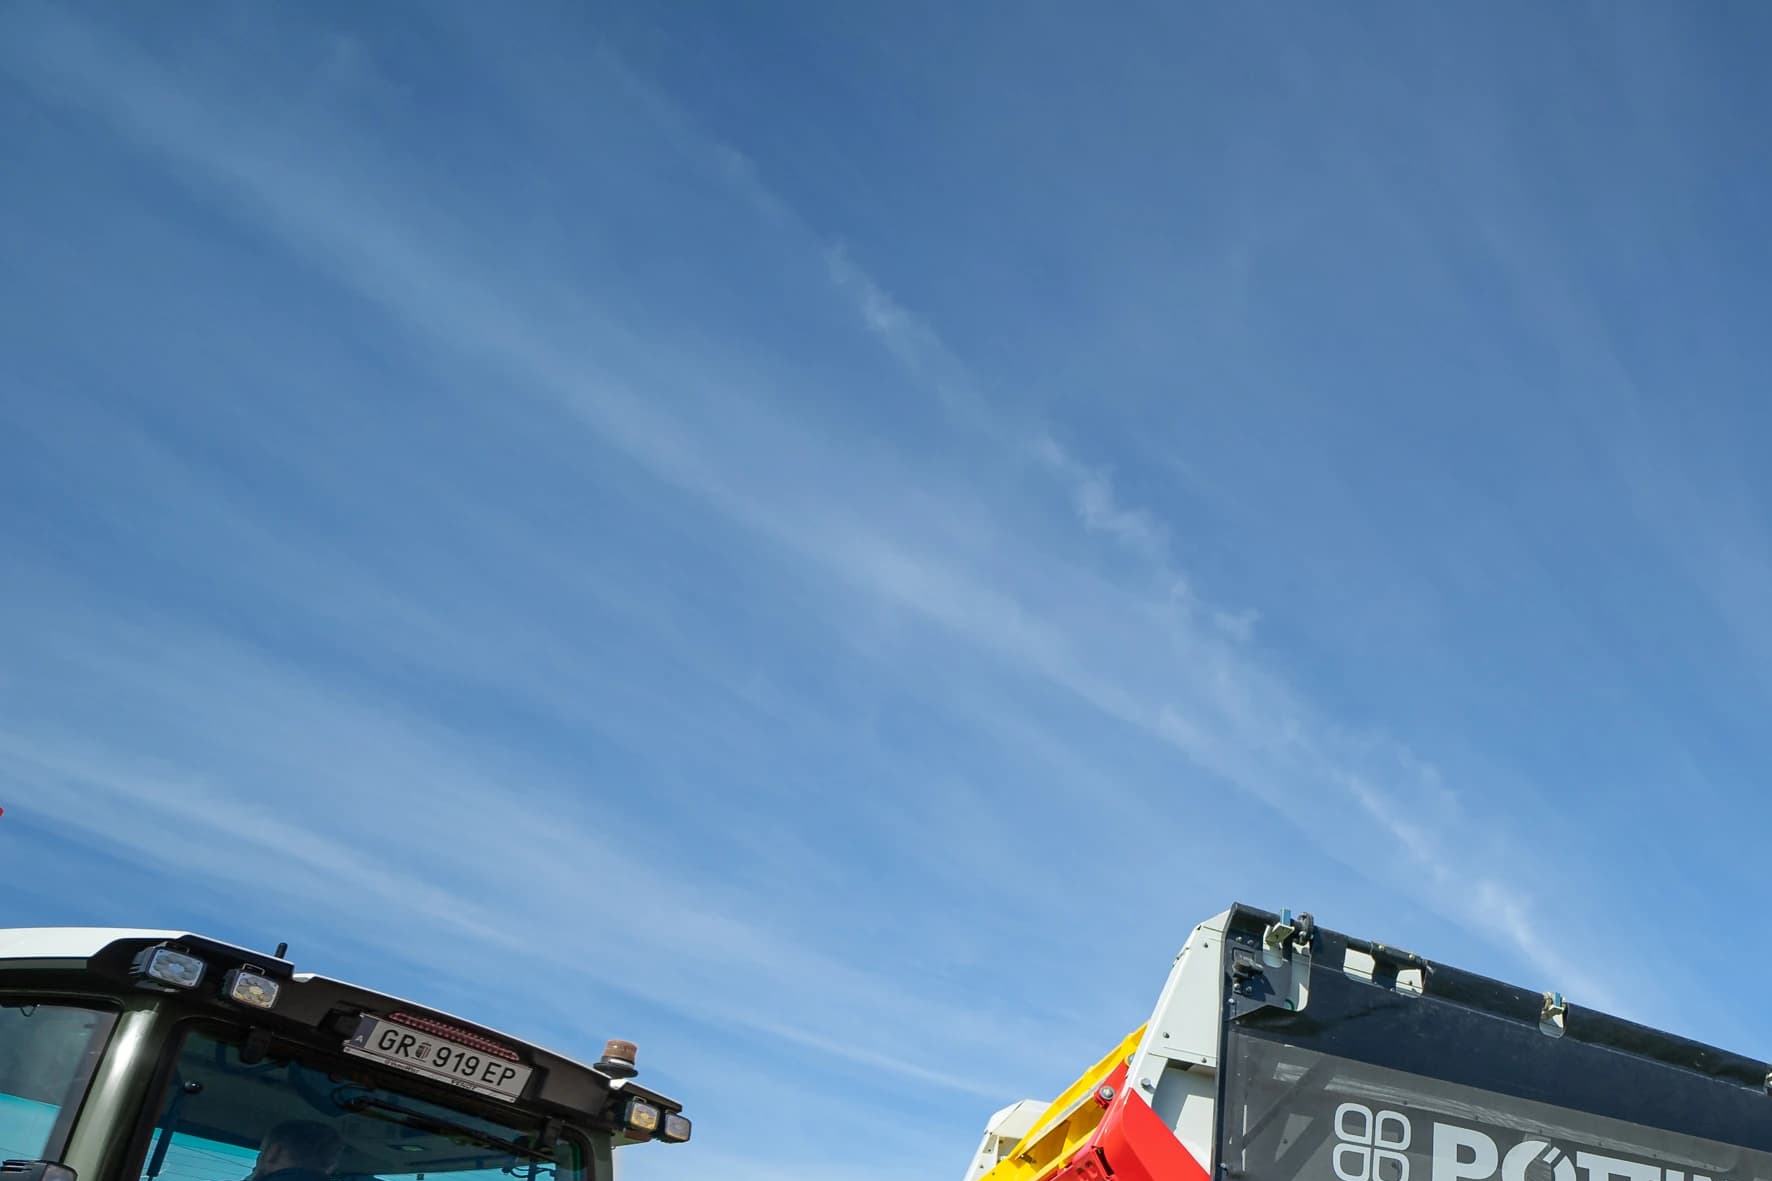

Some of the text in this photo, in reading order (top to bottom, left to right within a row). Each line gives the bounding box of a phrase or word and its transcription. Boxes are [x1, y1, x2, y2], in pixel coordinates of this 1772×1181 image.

[355, 1034, 363, 1043] A
[378, 1029, 416, 1057] GR
[433, 1047, 480, 1076] 919
[481, 1062, 516, 1086] EP
